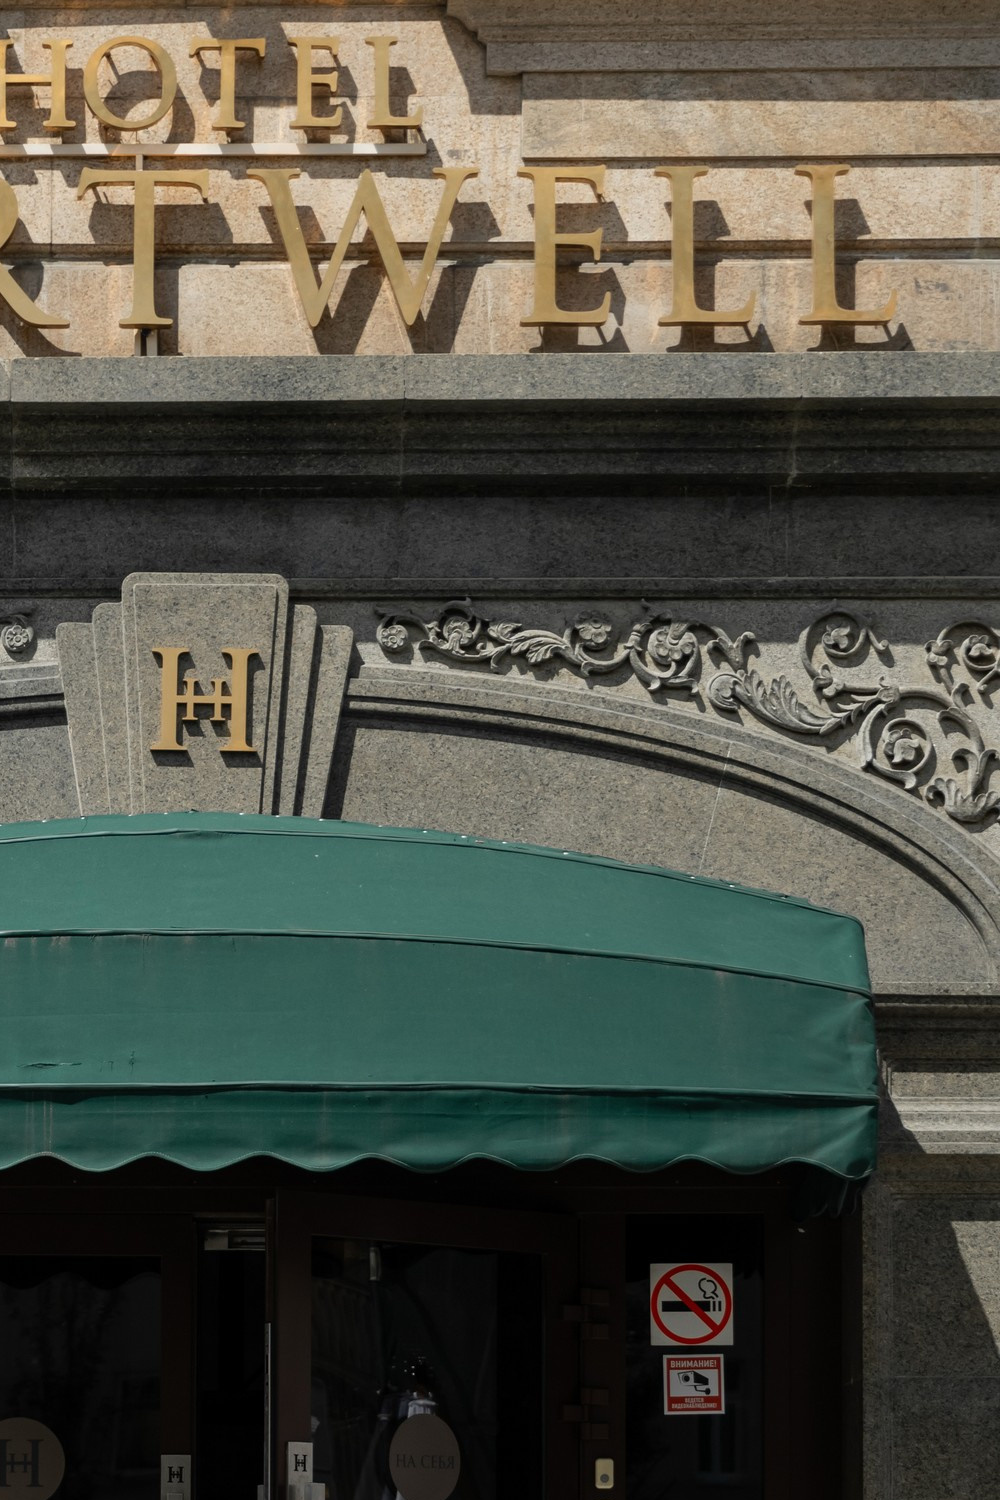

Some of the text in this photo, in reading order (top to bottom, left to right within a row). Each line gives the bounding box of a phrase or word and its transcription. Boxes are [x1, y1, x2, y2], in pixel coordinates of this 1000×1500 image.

[670, 1359, 717, 1368] ВНИМАНИЕ!
[396, 1453, 455, 1470] НА СЕБЯ
